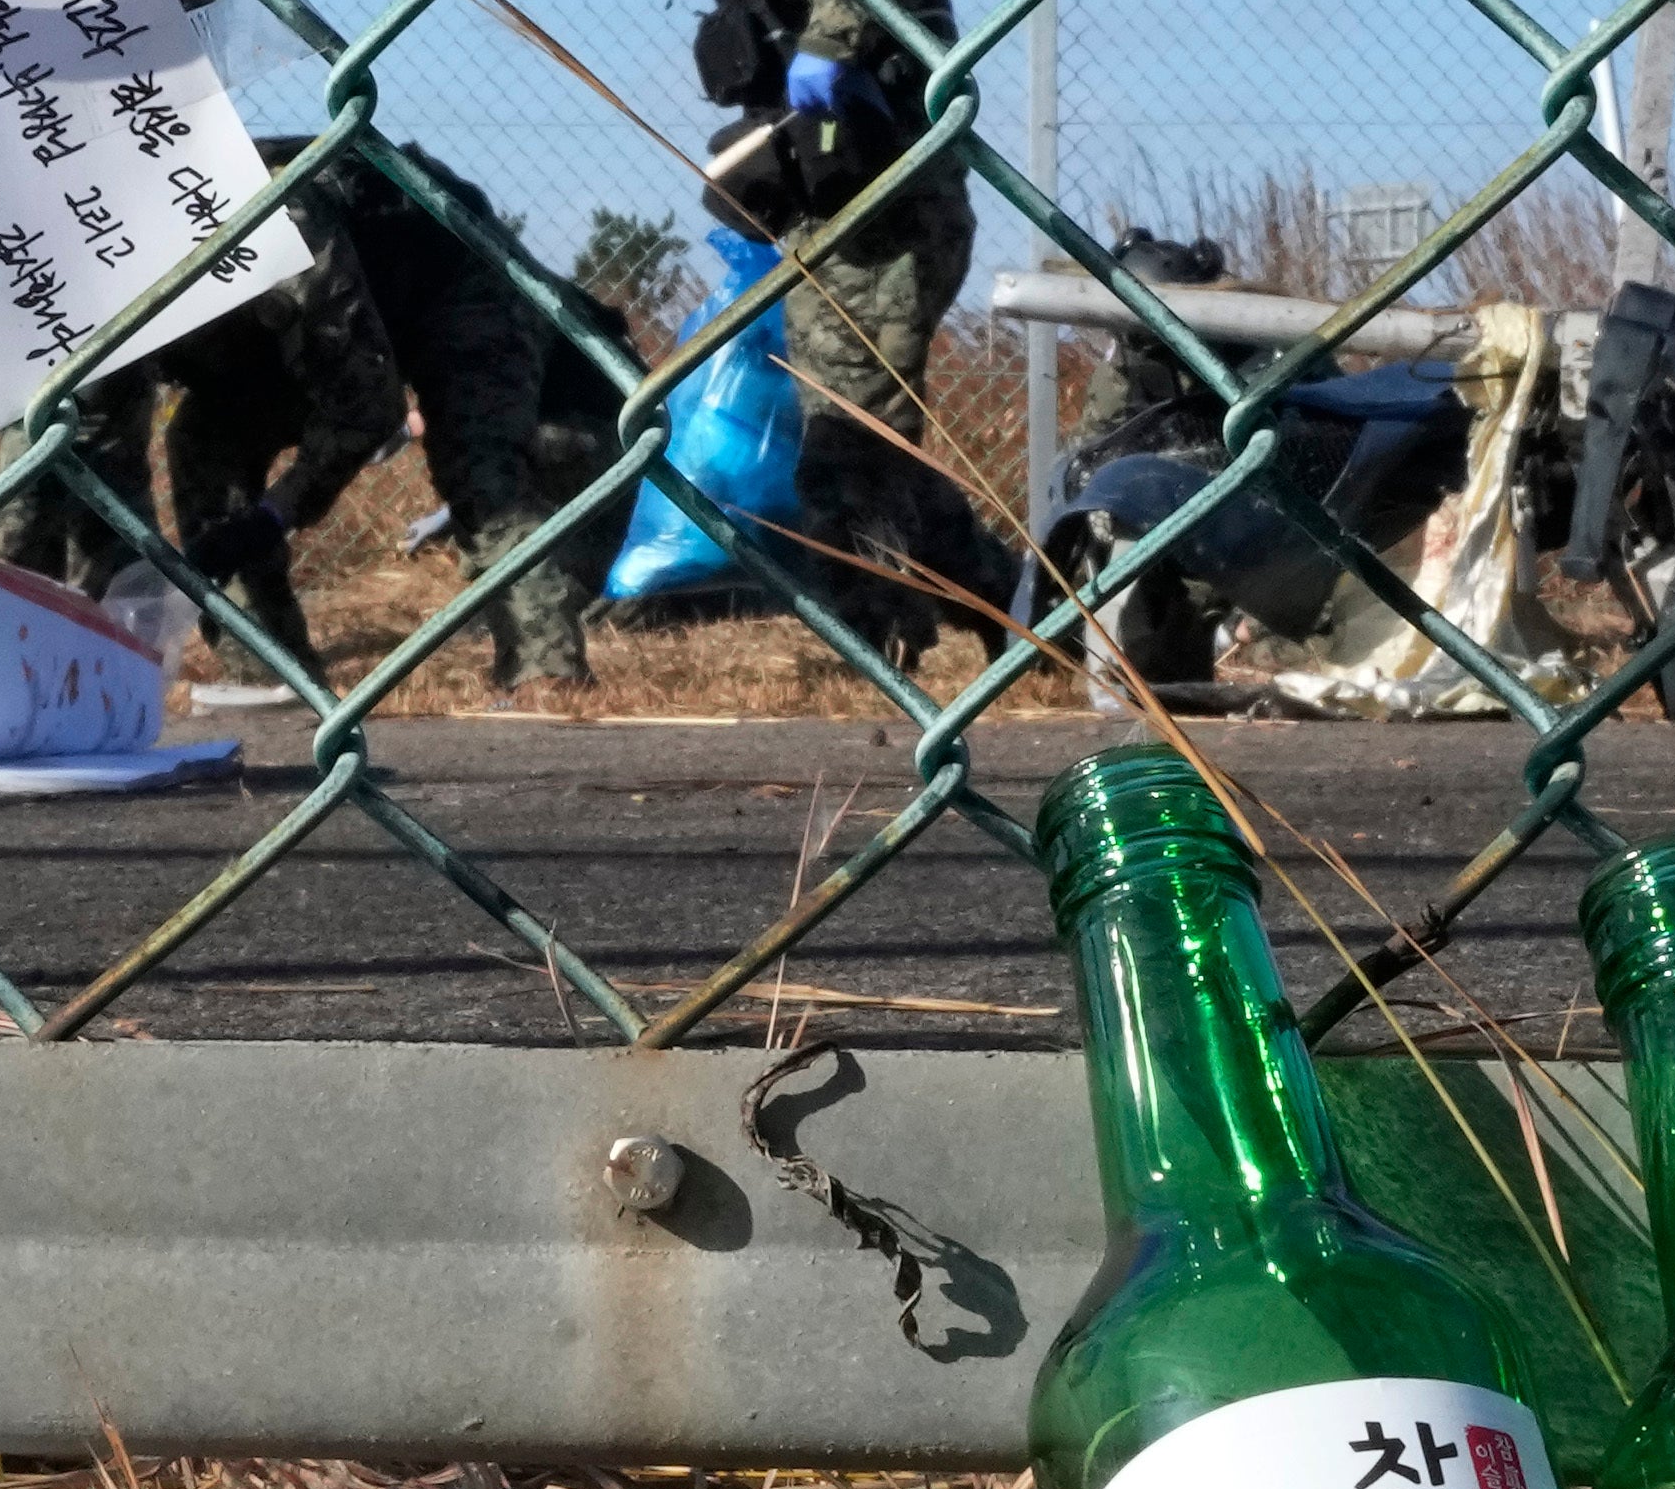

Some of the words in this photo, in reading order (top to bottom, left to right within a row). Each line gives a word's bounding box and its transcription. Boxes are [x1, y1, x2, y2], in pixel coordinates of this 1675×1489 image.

[64, 186, 135, 268] 그리고
[110, 70, 191, 158] 최선을
[168, 167, 258, 283] 다하을
